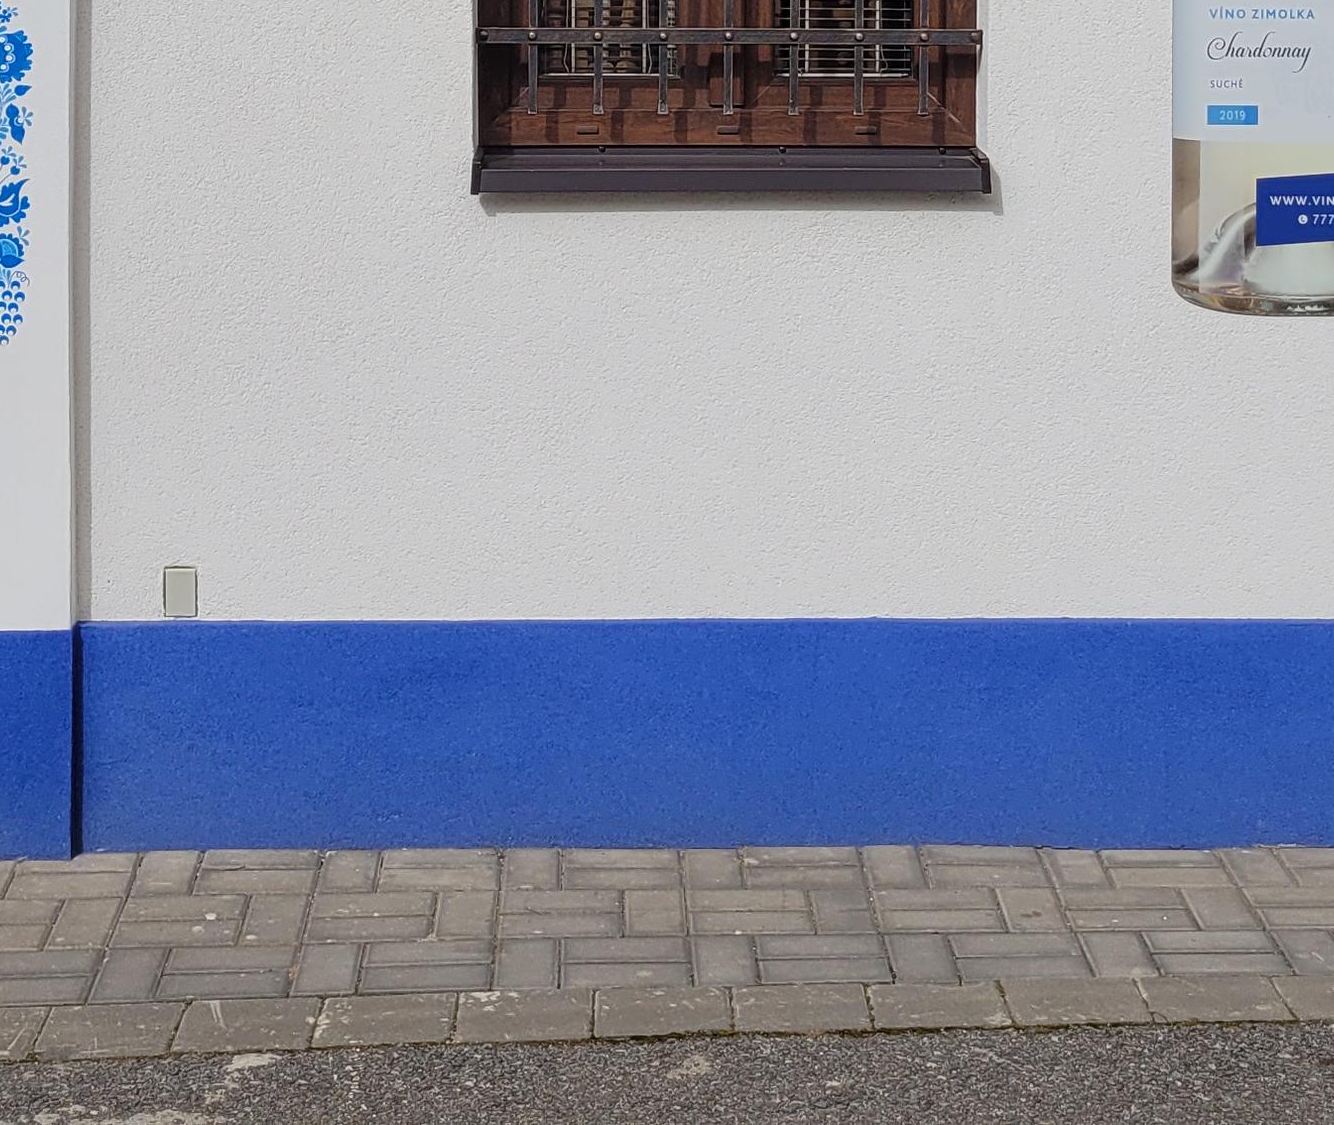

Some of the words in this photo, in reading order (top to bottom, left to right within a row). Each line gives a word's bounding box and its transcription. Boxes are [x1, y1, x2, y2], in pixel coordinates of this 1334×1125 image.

[1209, 6, 1247, 20] VÍNO
[1251, 9, 1316, 20] ZIMOLKA
[1206, 30, 1312, 74] Chardonnay
[1210, 78, 1244, 89] SUCHÉ
[1219, 109, 1247, 122] 2019
